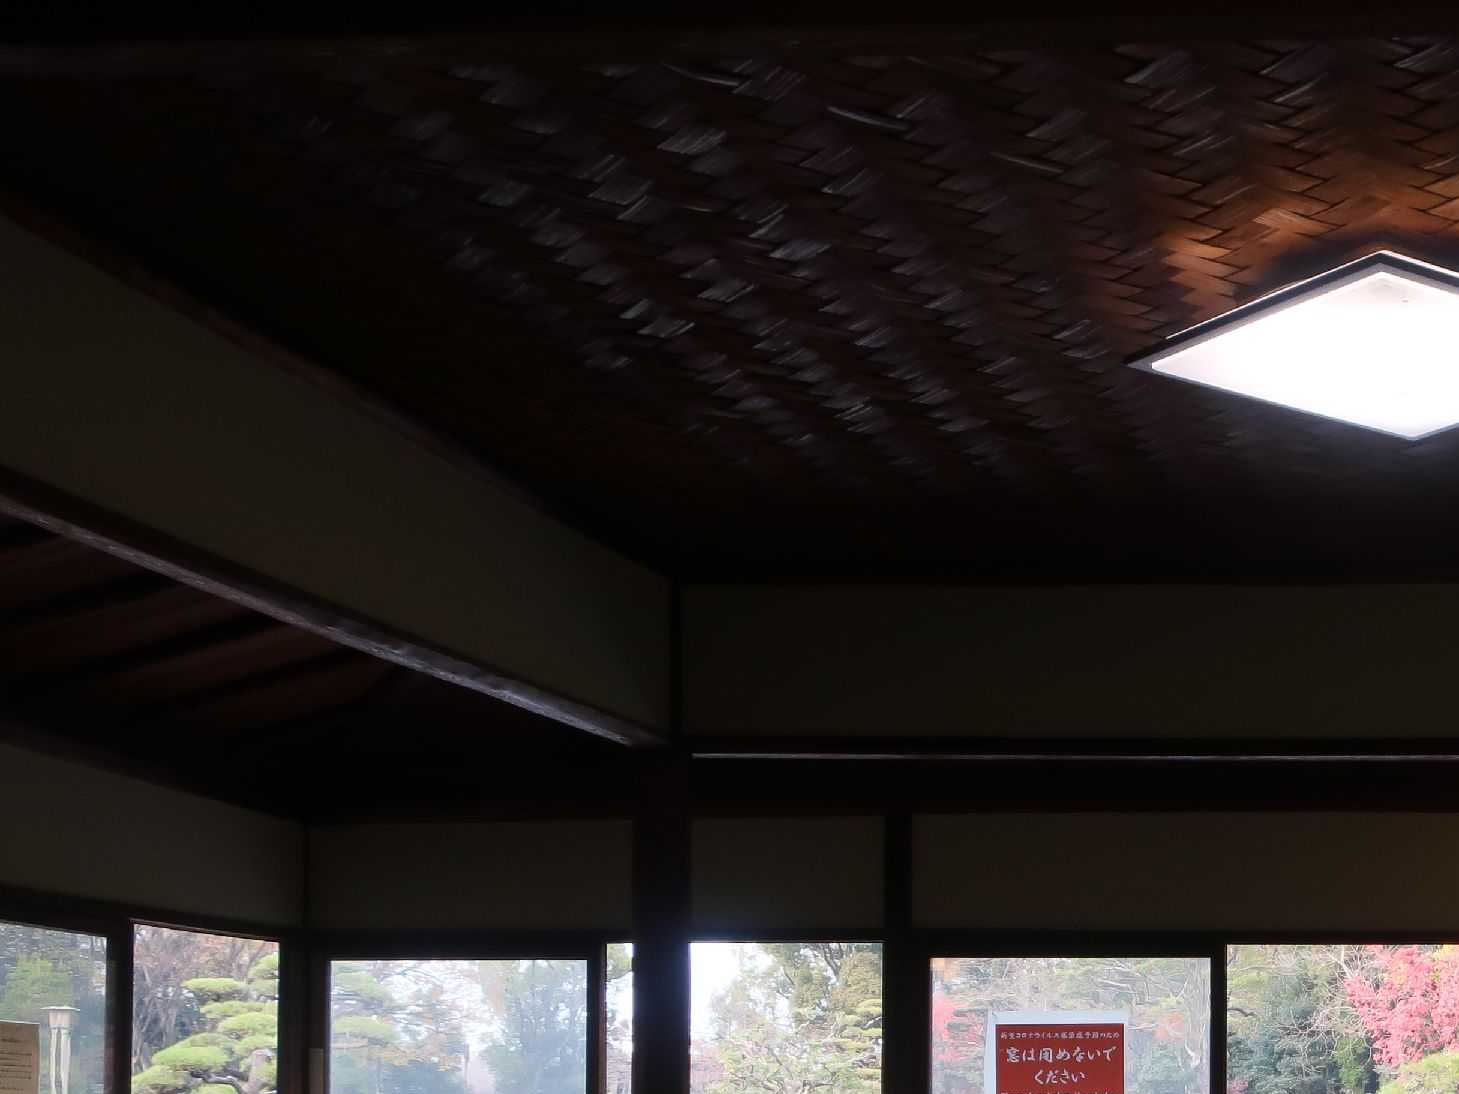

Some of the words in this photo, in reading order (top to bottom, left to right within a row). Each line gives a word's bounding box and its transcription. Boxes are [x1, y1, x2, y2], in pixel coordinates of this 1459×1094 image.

[1006, 1046, 1117, 1063] 窓は閉めないで
[1034, 1068, 1086, 1085] ください
